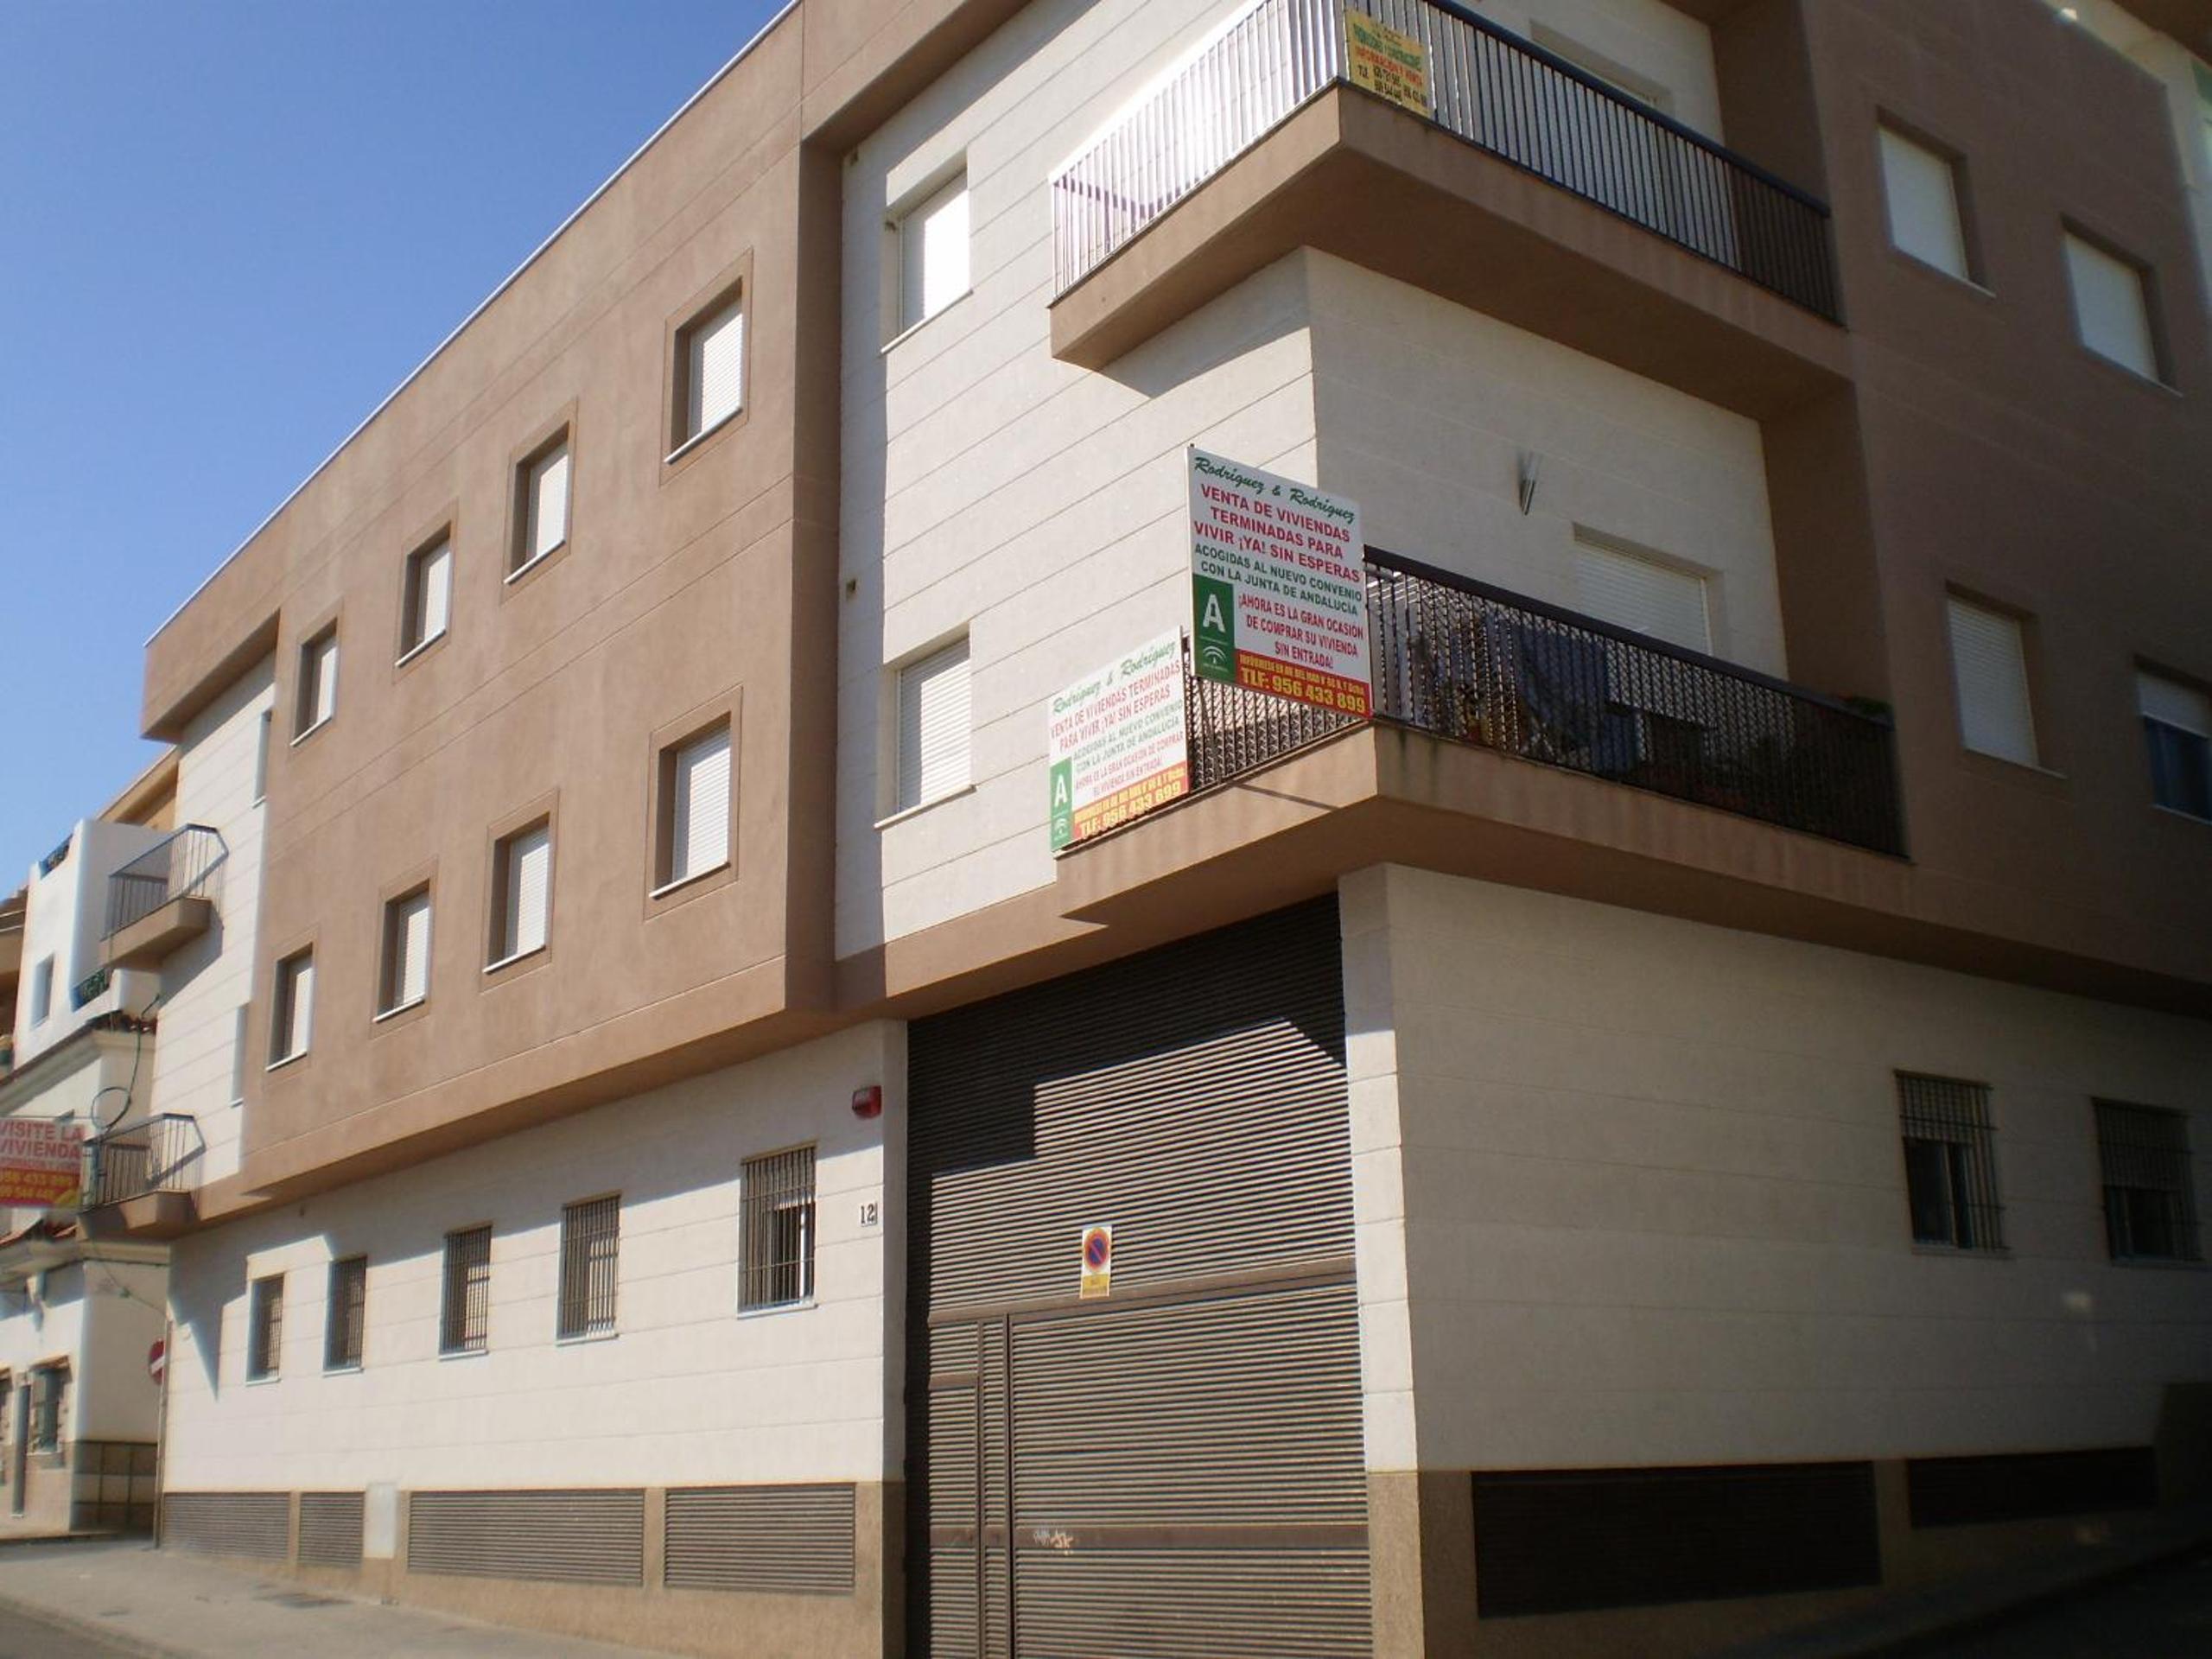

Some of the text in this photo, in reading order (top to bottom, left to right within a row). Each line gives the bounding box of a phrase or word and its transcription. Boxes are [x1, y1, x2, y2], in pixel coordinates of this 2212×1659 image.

[1272, 485, 1281, 496] &
[1201, 483, 1351, 543] VENTA DE VIVIENDAS
[1210, 505, 1344, 560] TERMINADAS PARA
[1194, 521, 1234, 545] VIVIR
[1270, 543, 1294, 563] SIN
[1298, 551, 1361, 583] ESPERAS
[1195, 543, 1362, 602] ACOGIDAS AL NUEVO CONVENIO
[1201, 561, 1358, 616] CON LA JUNTA DE ANDALUCIA
[1202, 594, 1226, 633] A
[1274, 602, 1285, 616] ES
[1287, 607, 1298, 620] LA
[1300, 610, 1324, 627] GRAN
[1326, 617, 1363, 639] OCASION
[1246, 614, 1358, 657] DE COMPRAR SU VIVIENDA
[1274, 641, 1289, 657] SIN
[1074, 709, 1085, 726] DE
[1085, 690, 1128, 721] VIVIENDAS
[1128, 659, 1180, 697] TERMINADAS
[1118, 705, 1132, 723] SIN
[1133, 687, 1171, 717] ESPERAS
[1242, 665, 1270, 690] TLF:
[1272, 674, 1303, 696] 956
[1306, 684, 1334, 705] 433
[1337, 693, 1365, 713] 899
[1054, 774, 1068, 808] A
[61, 1125, 85, 1141] LA
[861, 1203, 874, 1224] 12
